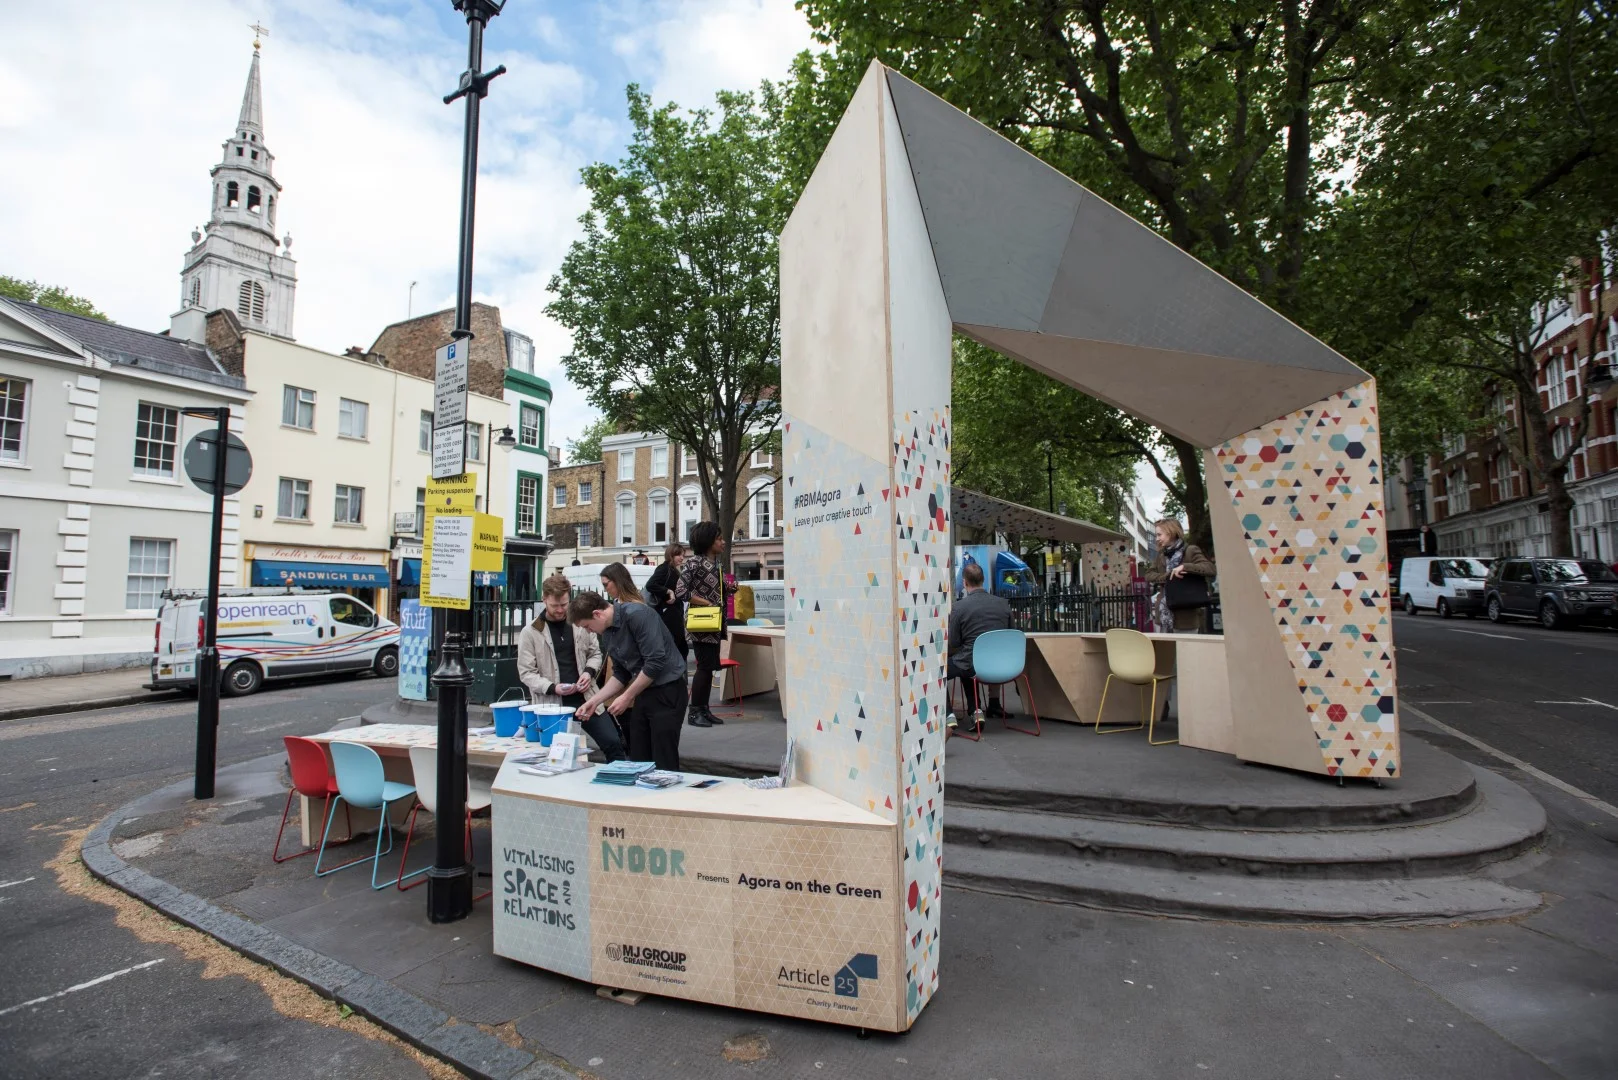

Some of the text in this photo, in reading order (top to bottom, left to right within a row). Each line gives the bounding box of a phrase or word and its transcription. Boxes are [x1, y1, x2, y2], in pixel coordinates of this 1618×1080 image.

[794, 489, 840, 509] #RBMAgora
[795, 502, 872, 527] Leave your creative touch
[480, 533, 498, 542] WARNING
[346, 551, 366, 561] Bar
[474, 543, 486, 552] Parking
[280, 571, 347, 580] SANDWICH
[217, 602, 306, 620] openreach
[401, 608, 427, 629] Stuff
[602, 826, 625, 839] RBM
[503, 848, 575, 874] VITALISING
[601, 840, 686, 877] NOOR
[503, 868, 571, 906] SPACE AND
[697, 873, 730, 884] Presents
[738, 873, 882, 899] Agora on the Green
[504, 898, 576, 930] RELATIONS
[623, 944, 686, 964] MJ GROUP
[623, 957, 686, 972] CREATIVE IMAGING
[638, 972, 687, 985] Printing Sponsor
[778, 966, 830, 986] Article
[837, 977, 854, 994] 25
[807, 998, 858, 1011] Charity Partner
